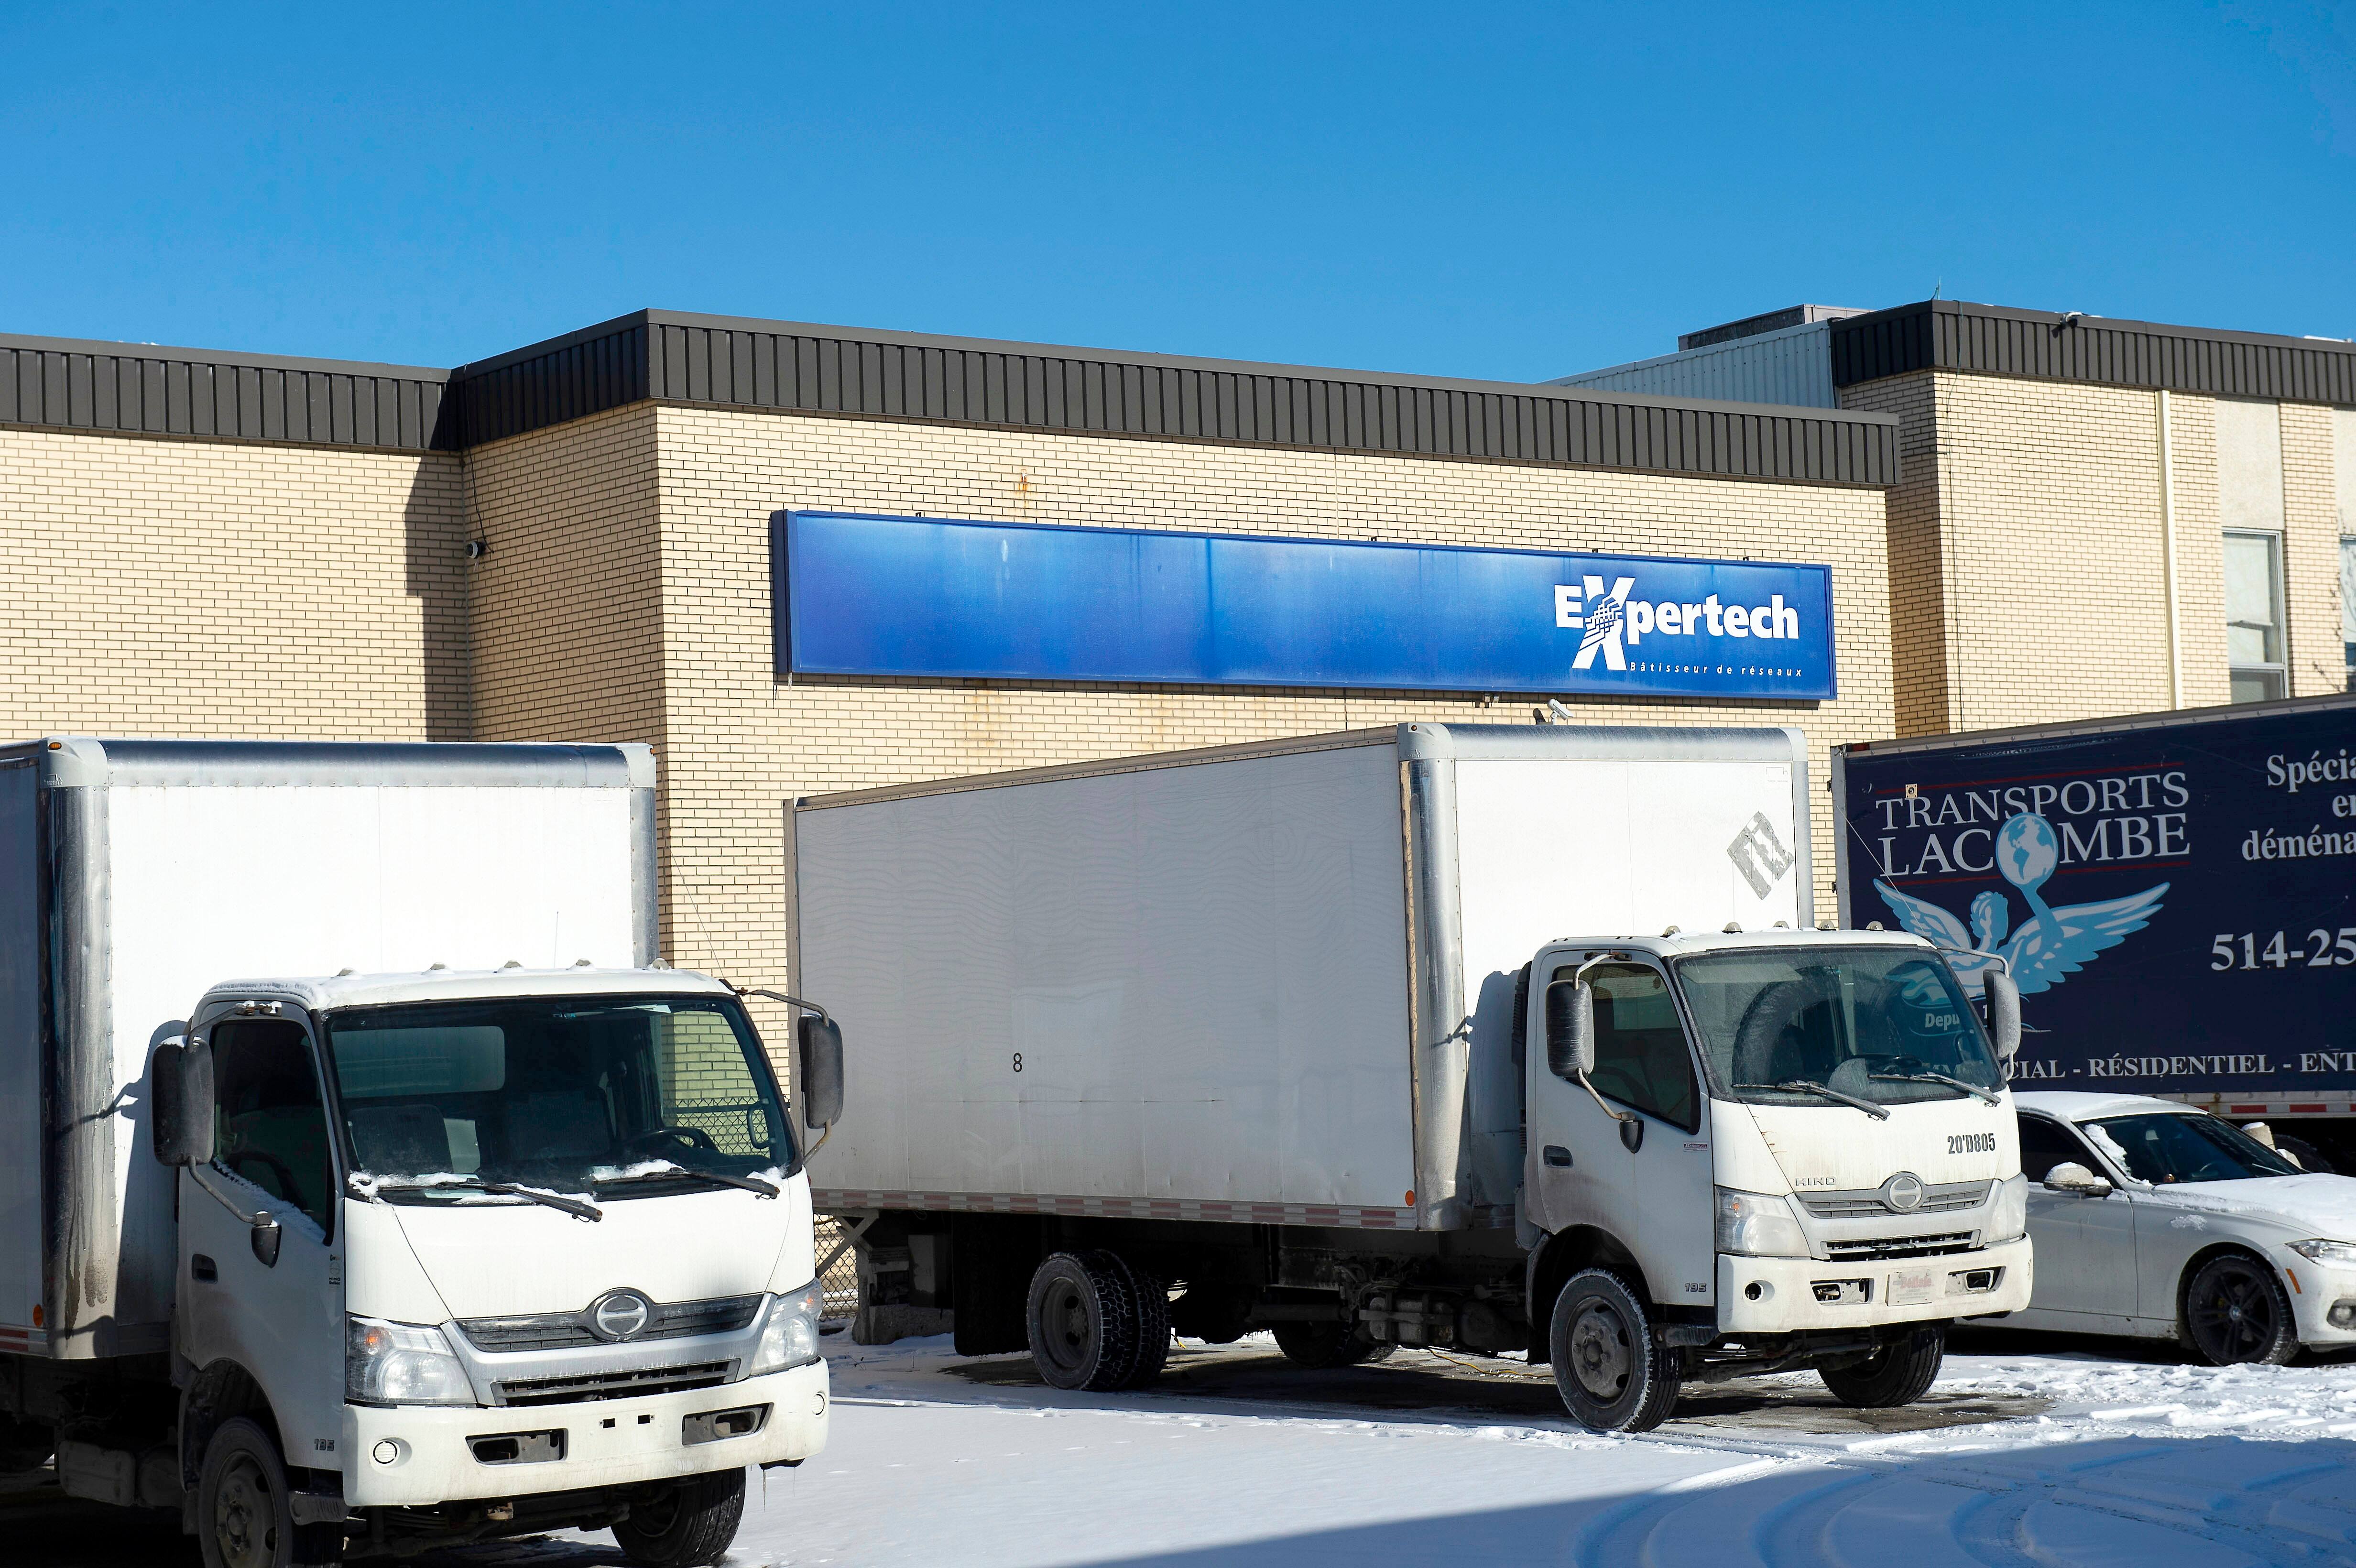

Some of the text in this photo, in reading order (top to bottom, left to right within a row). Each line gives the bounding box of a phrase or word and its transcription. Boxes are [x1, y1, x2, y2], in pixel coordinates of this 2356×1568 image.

[1630, 662, 1802, 676] Bâtisseur de réseaux
[1876, 771, 2190, 830] TRANSPORTS
[2211, 927, 2356, 971] 514-25
[1013, 1052, 1023, 1072] 8
[2087, 1052, 2276, 1077] RÉSIDENTIEL
[1947, 1132, 1996, 1154] 20'D805
[1795, 1176, 1837, 1186] HINO
[1684, 1282, 1707, 1293] 195
[314, 1438, 335, 1451] 195
